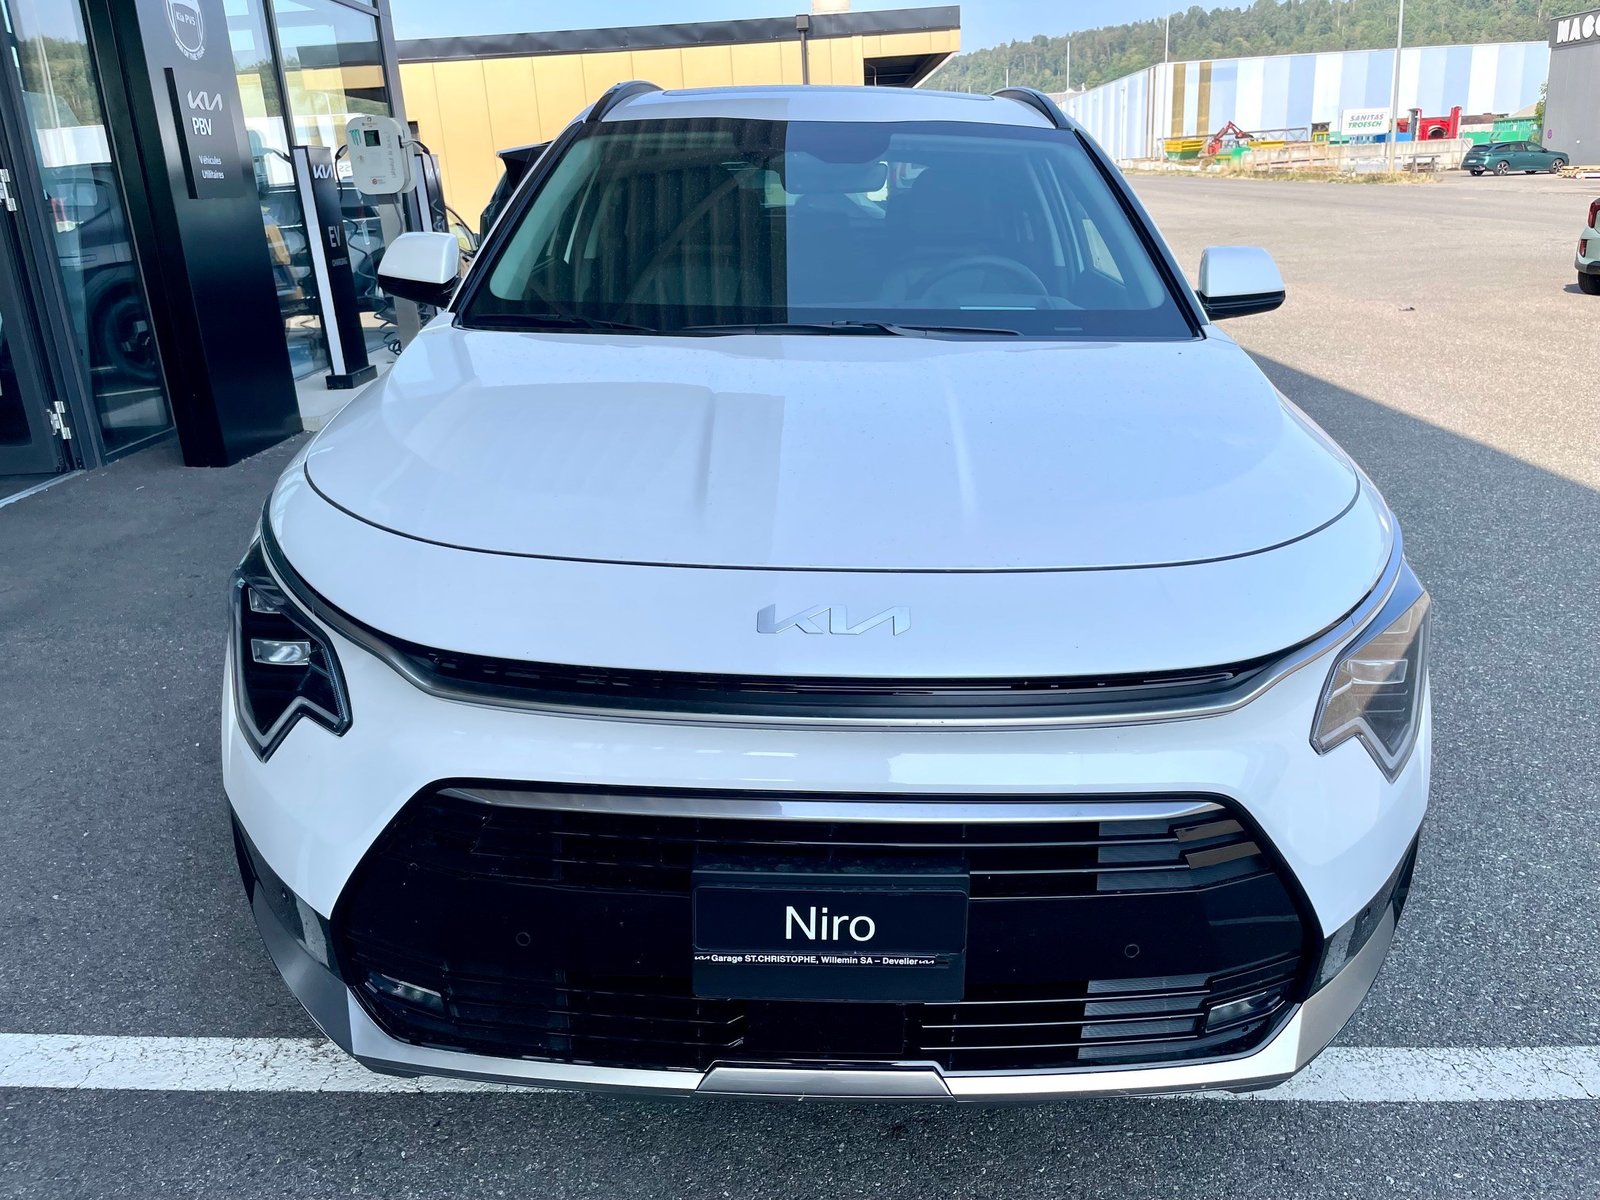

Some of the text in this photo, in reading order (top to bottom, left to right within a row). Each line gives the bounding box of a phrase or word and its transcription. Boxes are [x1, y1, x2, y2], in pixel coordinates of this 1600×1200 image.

[187, 90, 223, 111] KIA
[192, 117, 212, 136] PBV
[1348, 121, 1382, 129] TROESCH
[1350, 113, 1384, 122] SANITAS
[202, 169, 225, 179] Utilitaires
[328, 225, 341, 248] EV
[757, 603, 912, 637] KIA
[785, 905, 876, 942] Niro
[711, 954, 743, 964] Garage
[744, 954, 819, 965] ST.CHRISTOPHE,
[821, 956, 858, 964] Willemin
[860, 956, 873, 964] SA
[882, 957, 918, 965] Develier
